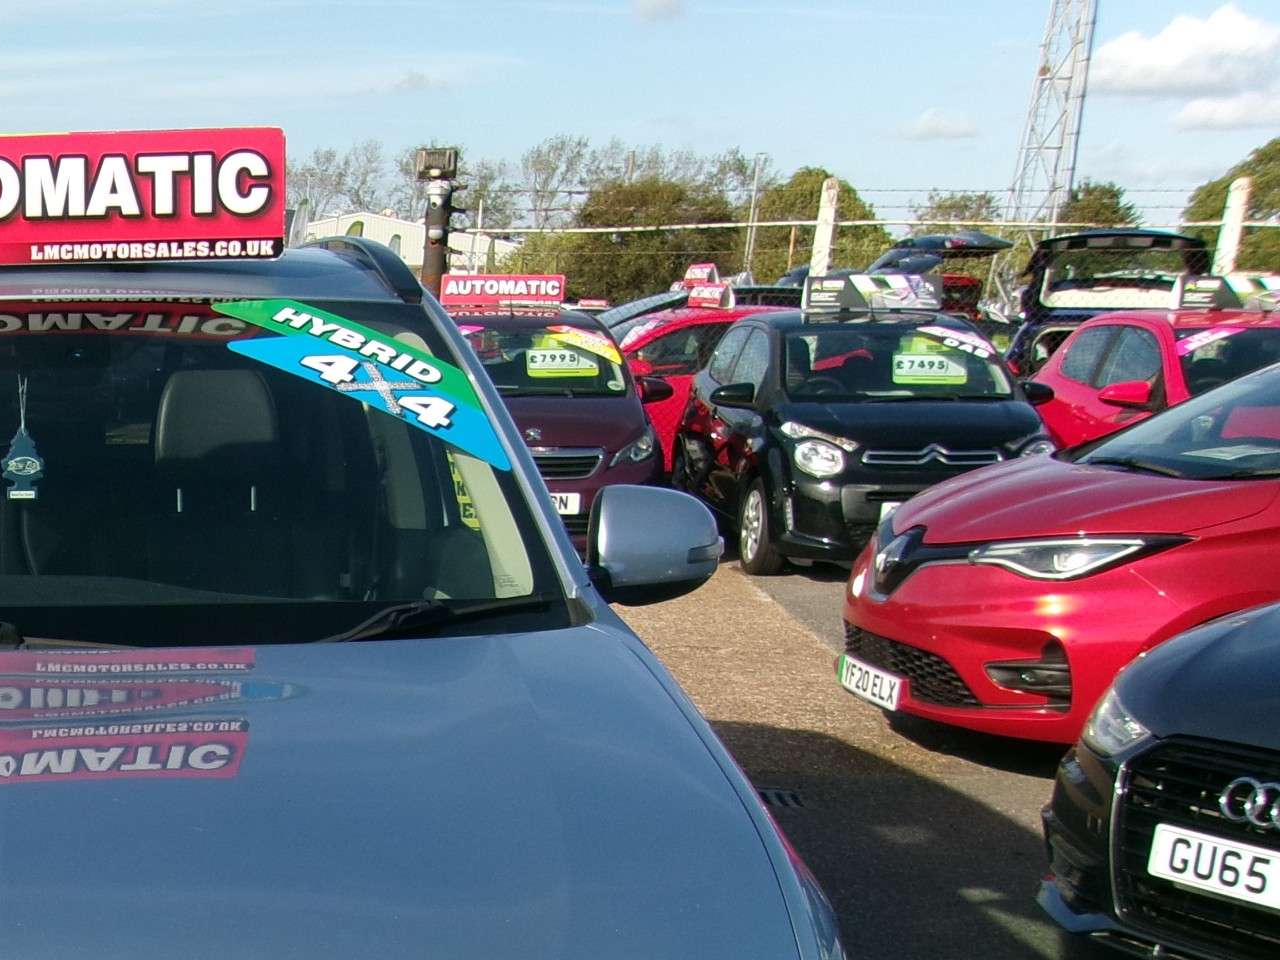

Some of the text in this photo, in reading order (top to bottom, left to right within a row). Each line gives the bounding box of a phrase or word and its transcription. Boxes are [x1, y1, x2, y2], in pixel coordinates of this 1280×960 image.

[29, 239, 275, 261] LMCMOTORSALES.CO.UK
[445, 279, 560, 296] AUTOMATIC
[271, 306, 443, 384] HYBRID
[844, 659, 897, 705] YF20 ELX
[1168, 837, 1271, 895] GU65
